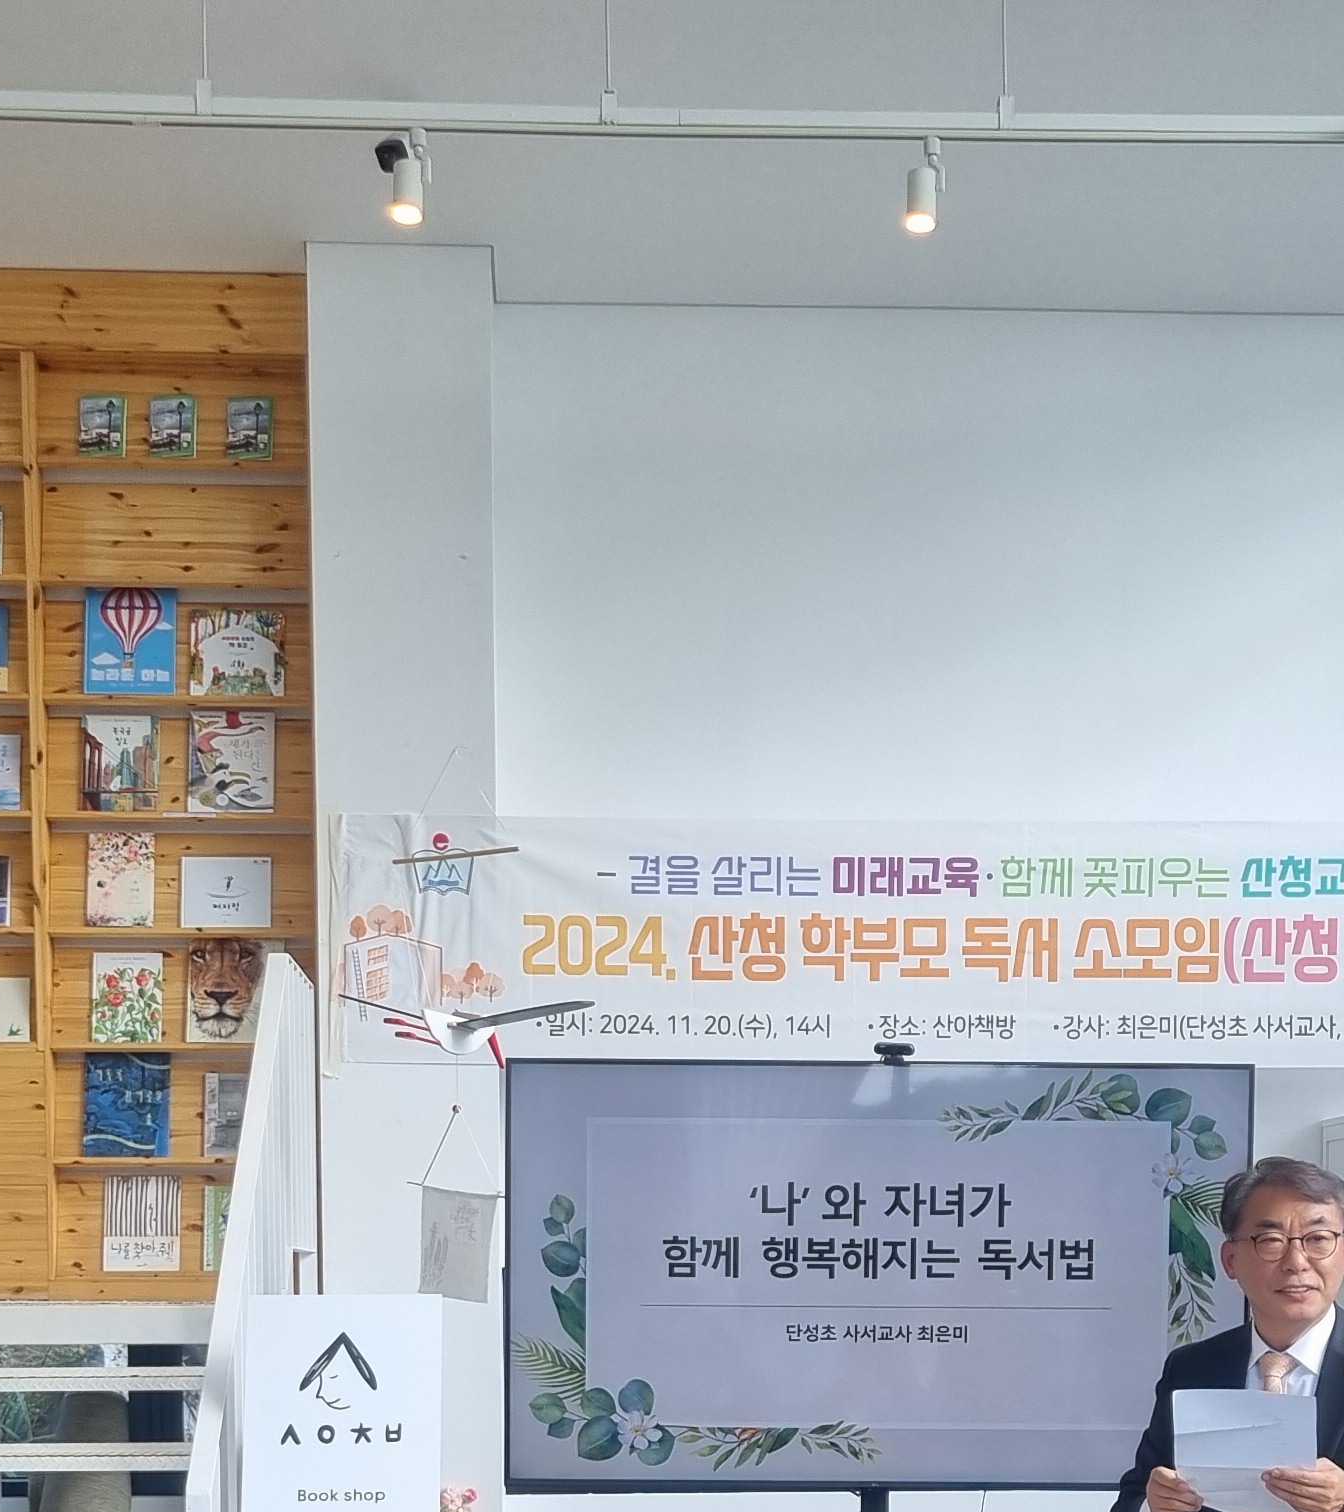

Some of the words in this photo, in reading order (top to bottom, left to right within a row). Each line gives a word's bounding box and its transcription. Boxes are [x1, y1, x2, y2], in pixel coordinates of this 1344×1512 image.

[628, 855, 701, 896] 결을
[711, 855, 822, 897] 살리는
[1083, 857, 1231, 898] 꽃피우는
[522, 914, 676, 981] 2024.
[687, 912, 787, 982] 산청
[799, 912, 950, 982] 학부모
[961, 917, 1059, 983] 독서
[599, 1014, 660, 1036] 2024.
[667, 1014, 698, 1036] 11.
[704, 1013, 778, 1040] 20.(수),
[785, 1013, 831, 1039] 14시
[932, 1014, 1017, 1040] 산아책방
[1116, 1014, 1249, 1041] 최은미(단성초
[1252, 1014, 1341, 1041] 사서교사,
[821, 1182, 867, 1227] 와
[883, 1182, 1012, 1228] 자녀가
[111, 1242, 131, 1260] 나를
[133, 1240, 157, 1260] 찾아
[662, 1235, 740, 1279] 함께
[761, 1236, 961, 1280] 행복해지는
[977, 1238, 1094, 1281] 독서법
[786, 1323, 838, 1343] 단성초
[842, 1324, 913, 1344] 사서교사
[916, 1324, 968, 1344] 최은미
[297, 1488, 339, 1502] Book
[343, 1488, 386, 1504] shop
